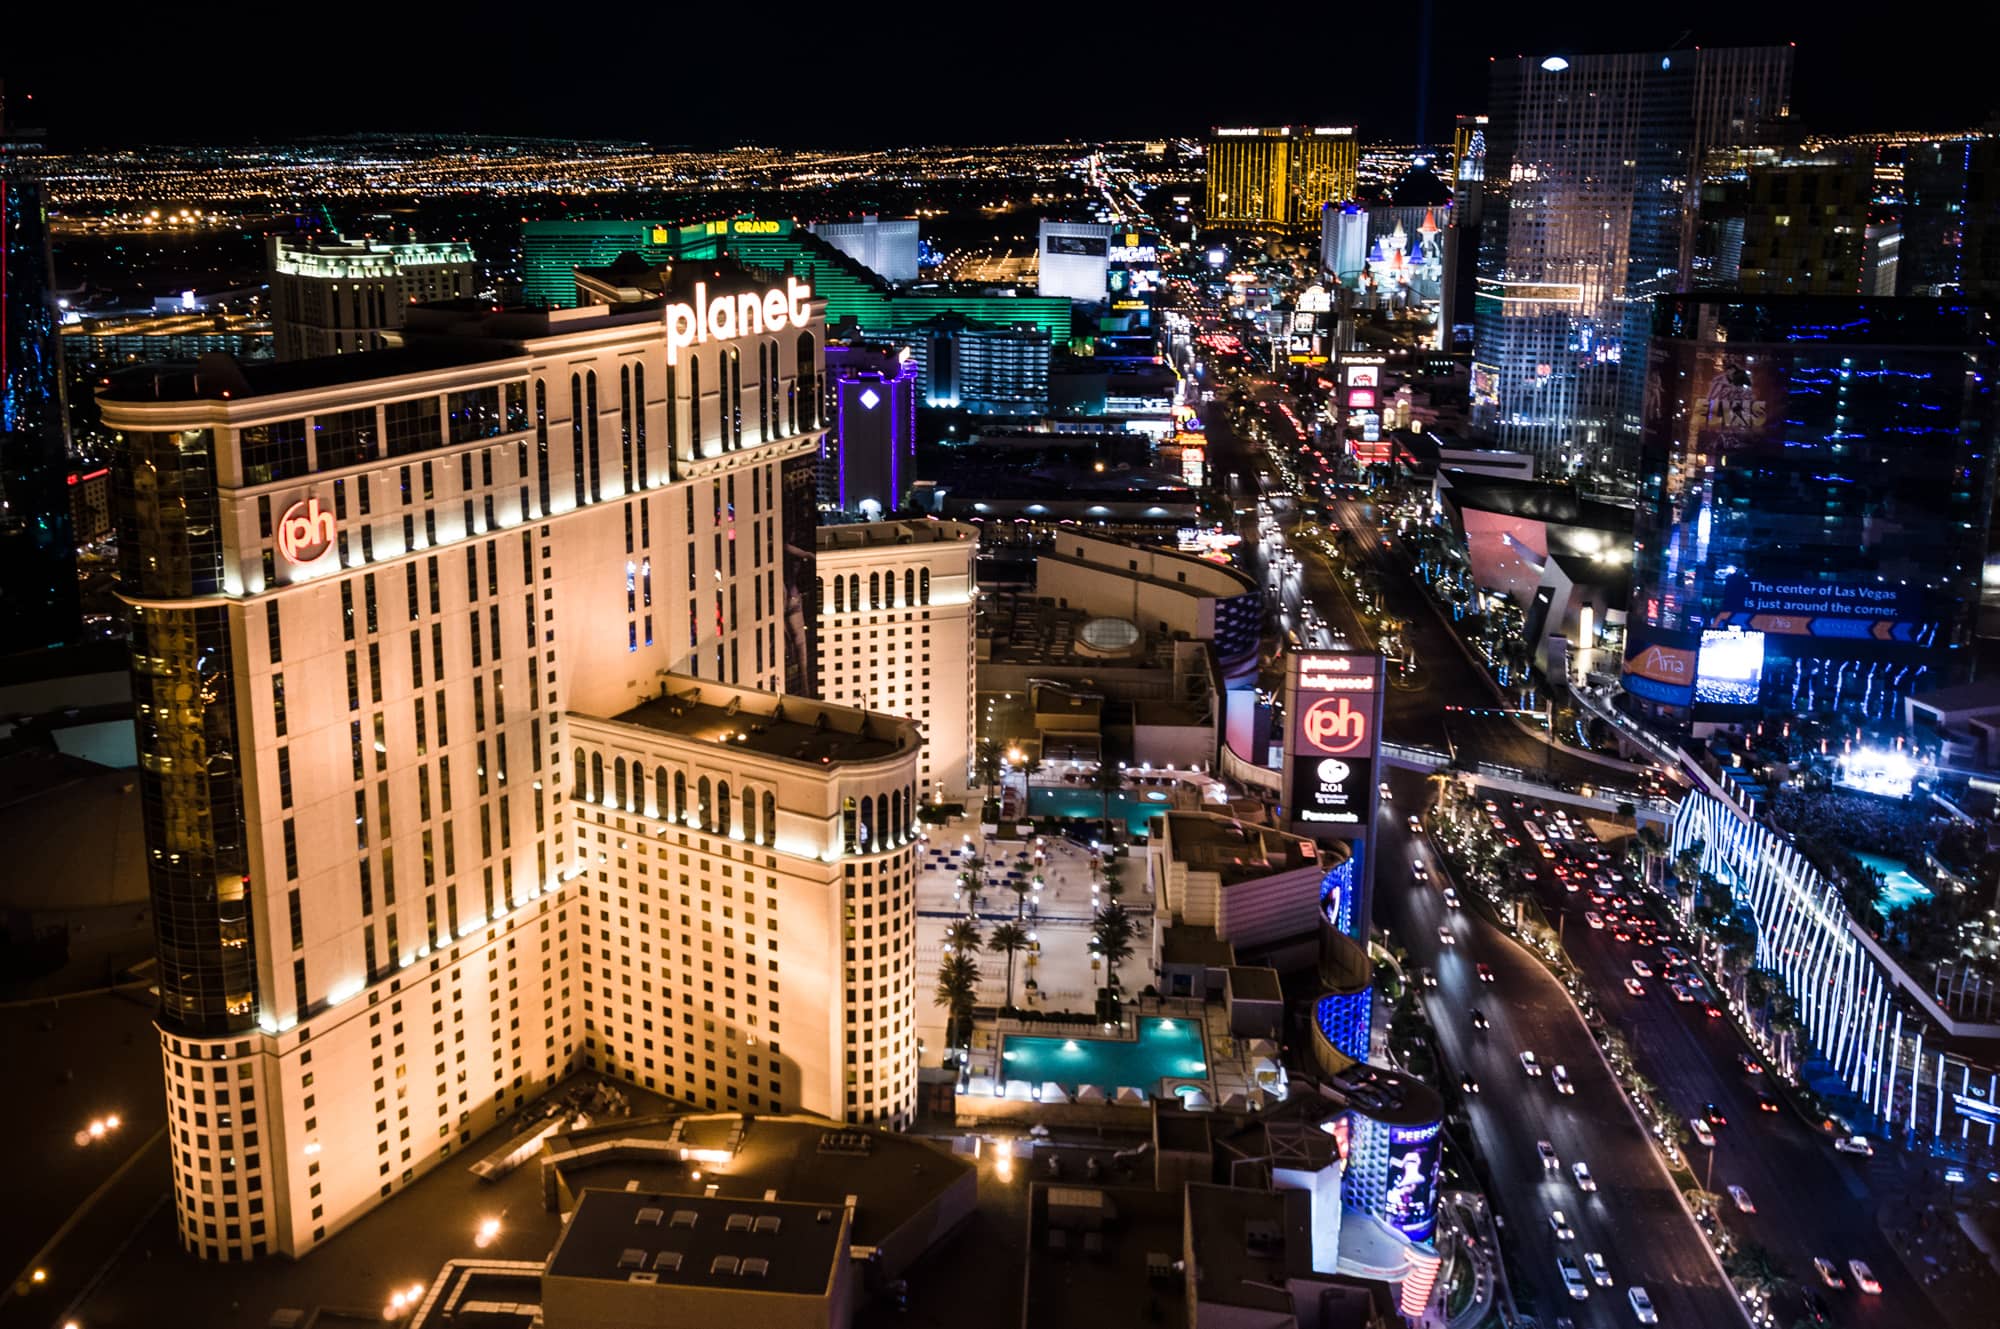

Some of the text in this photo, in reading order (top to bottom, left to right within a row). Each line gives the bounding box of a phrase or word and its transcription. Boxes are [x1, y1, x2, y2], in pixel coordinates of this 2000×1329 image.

[734, 221, 780, 233] GRAND
[1108, 246, 1156, 263] MGM
[666, 277, 811, 366] planet
[285, 498, 335, 560] ph
[1750, 581, 1897, 601] The center of Las Vegas
[1744, 597, 1899, 617] is just around the corner.
[1301, 656, 1350, 673] planet
[1646, 647, 1684, 673] Aria
[1301, 674, 1373, 691] hollywood
[1311, 697, 1365, 750] ph
[1320, 783, 1343, 793] KOI
